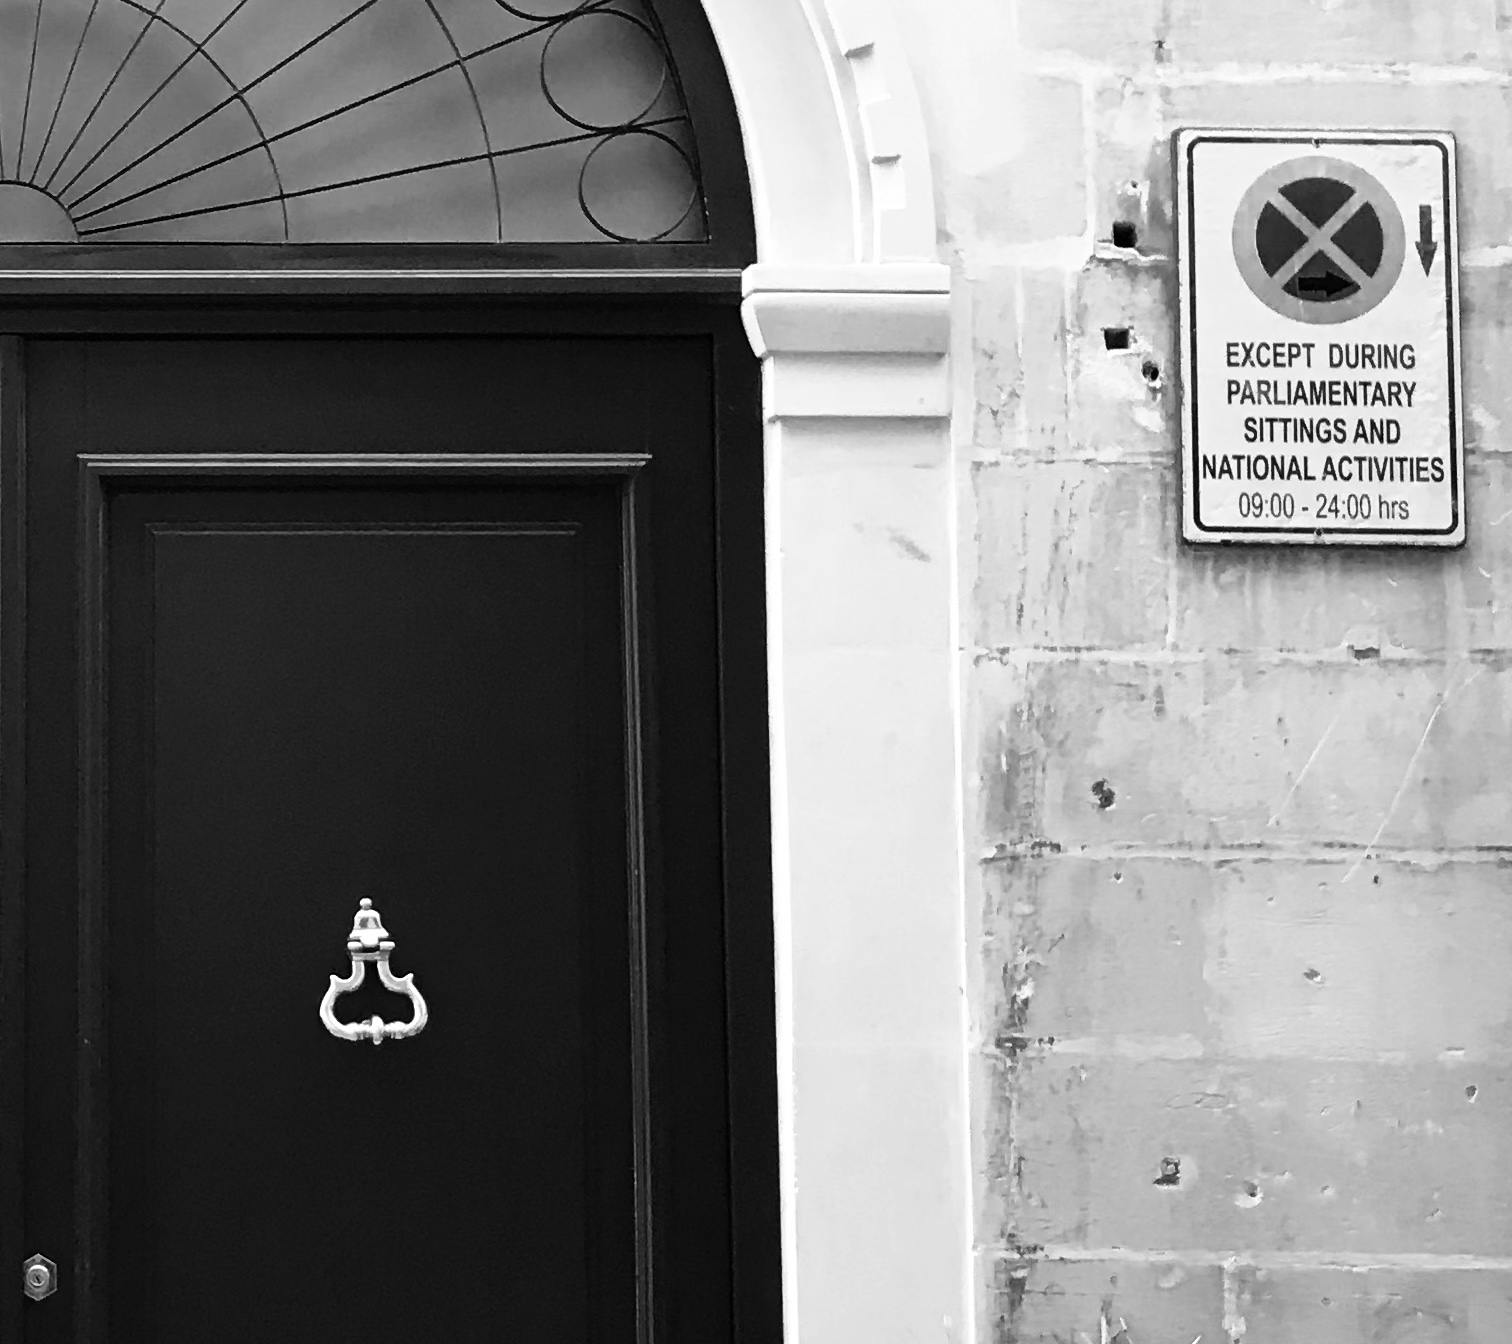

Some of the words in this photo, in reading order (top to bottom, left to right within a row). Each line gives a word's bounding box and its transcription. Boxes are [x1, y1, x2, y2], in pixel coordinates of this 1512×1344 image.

[1226, 341, 1316, 369] EXCEPT
[1328, 343, 1416, 370] DURING
[1226, 380, 1417, 408] PARLIAMENTARY
[1243, 416, 1347, 445] SITTINGS
[1352, 418, 1401, 445] AND
[1202, 453, 1316, 482] NATIONAL
[1321, 455, 1445, 483] ACTIVITIES
[1238, 491, 1295, 519] 09:00
[1315, 493, 1372, 520] 24:00
[1378, 494, 1410, 521] hrs
